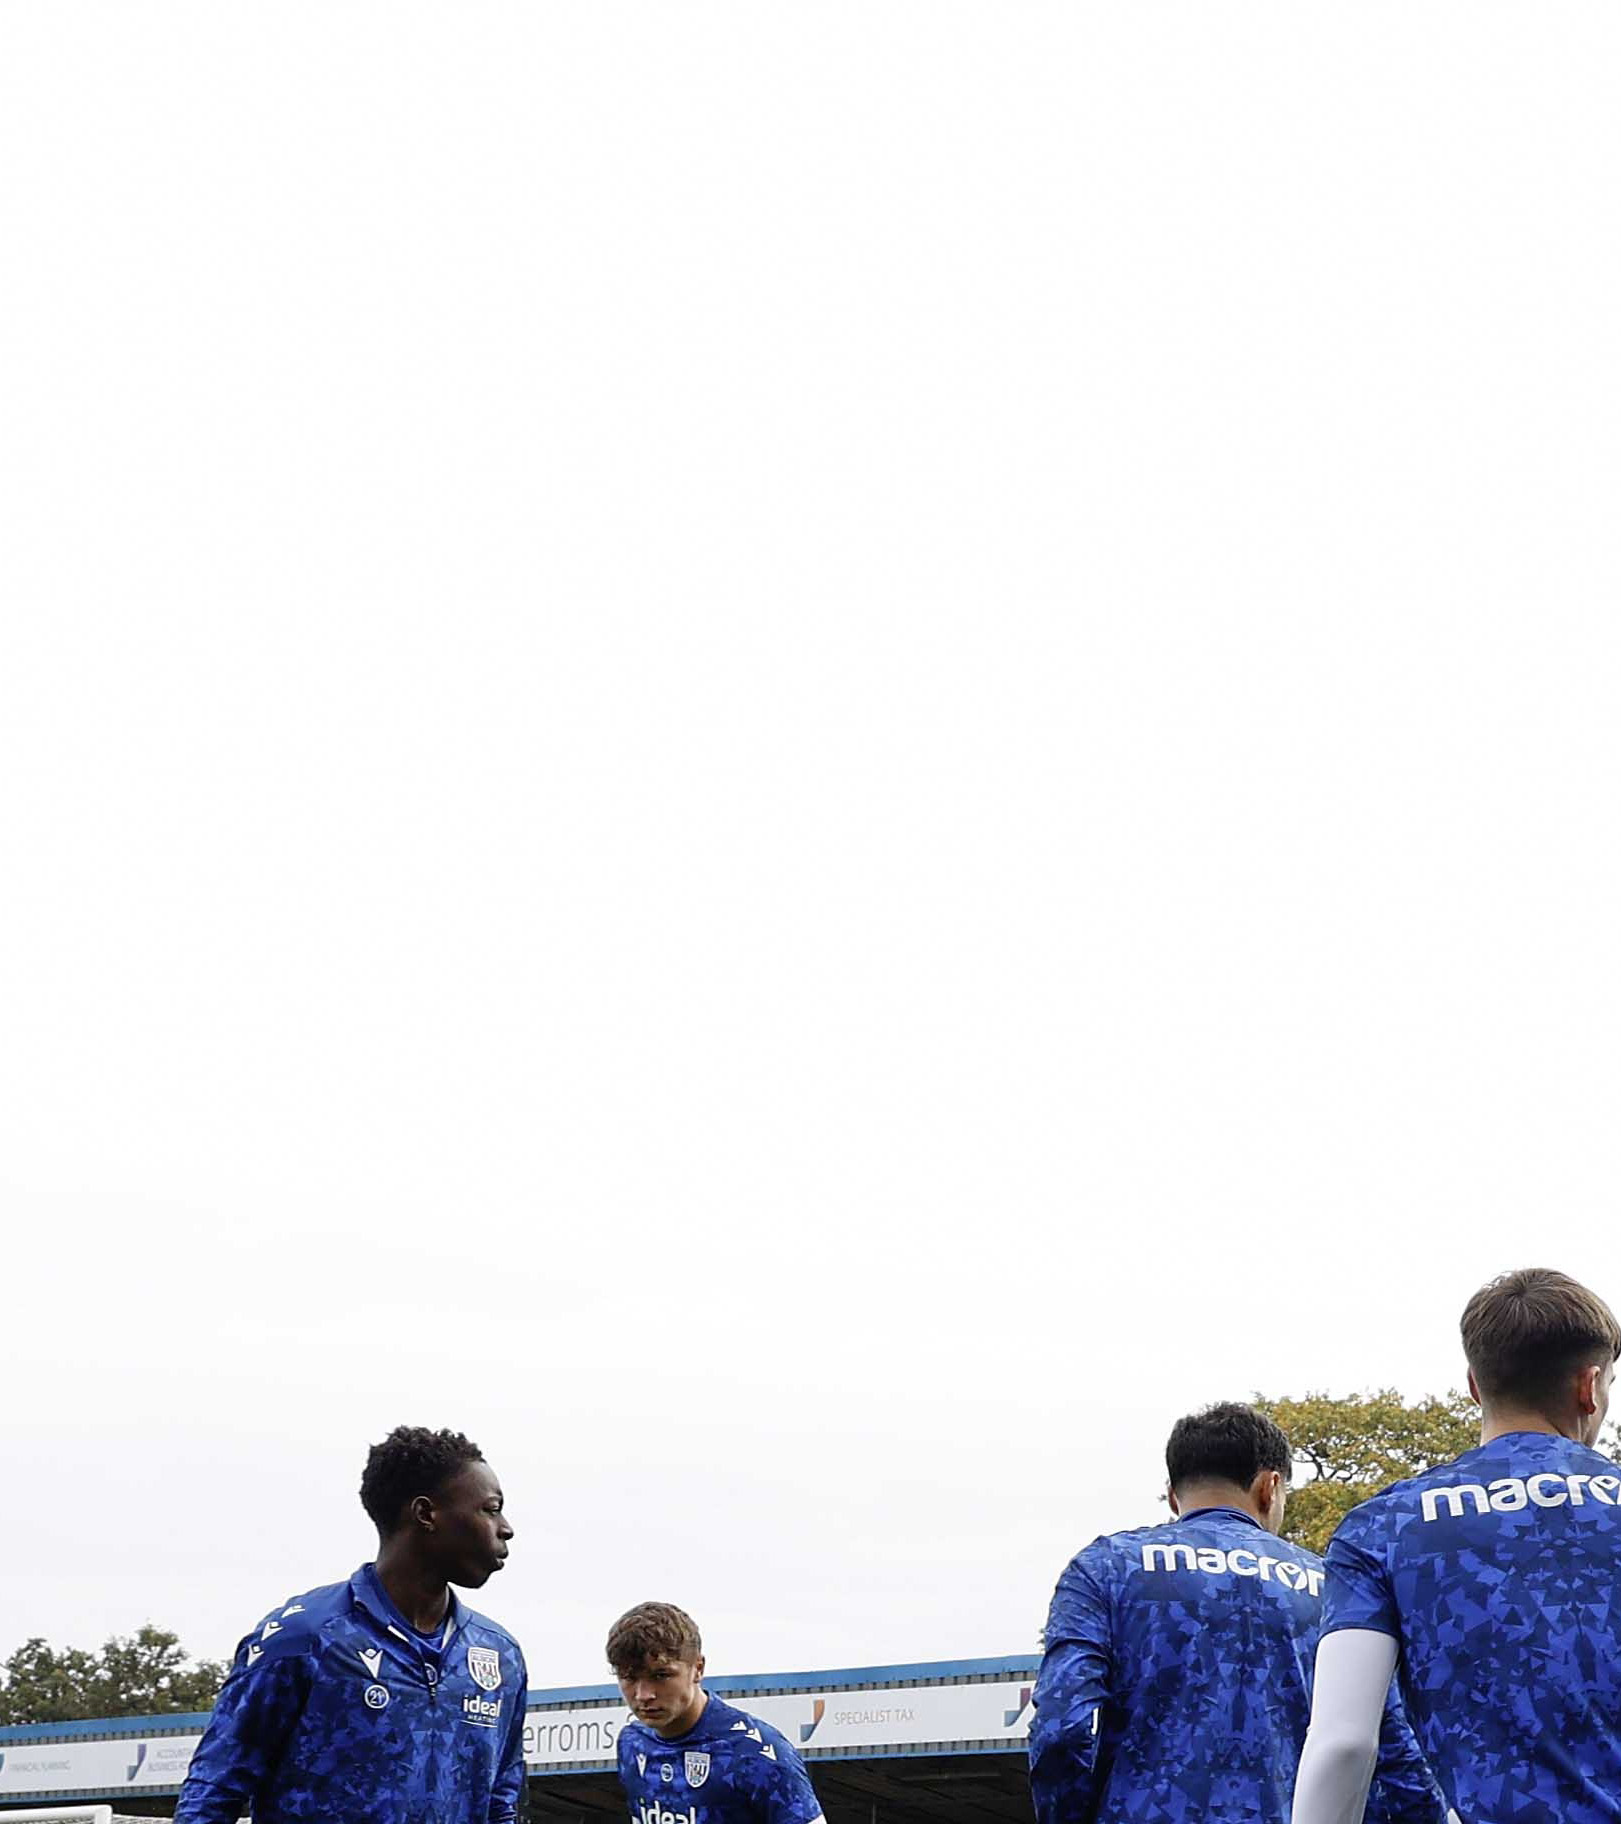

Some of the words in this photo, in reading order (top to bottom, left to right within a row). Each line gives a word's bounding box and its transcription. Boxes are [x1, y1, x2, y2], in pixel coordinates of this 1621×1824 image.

[463, 1695, 502, 1717] ideal
[834, 1709, 891, 1725] SPECIALIST
[895, 1709, 915, 1721] TAX
[523, 1720, 614, 1754] erroms
